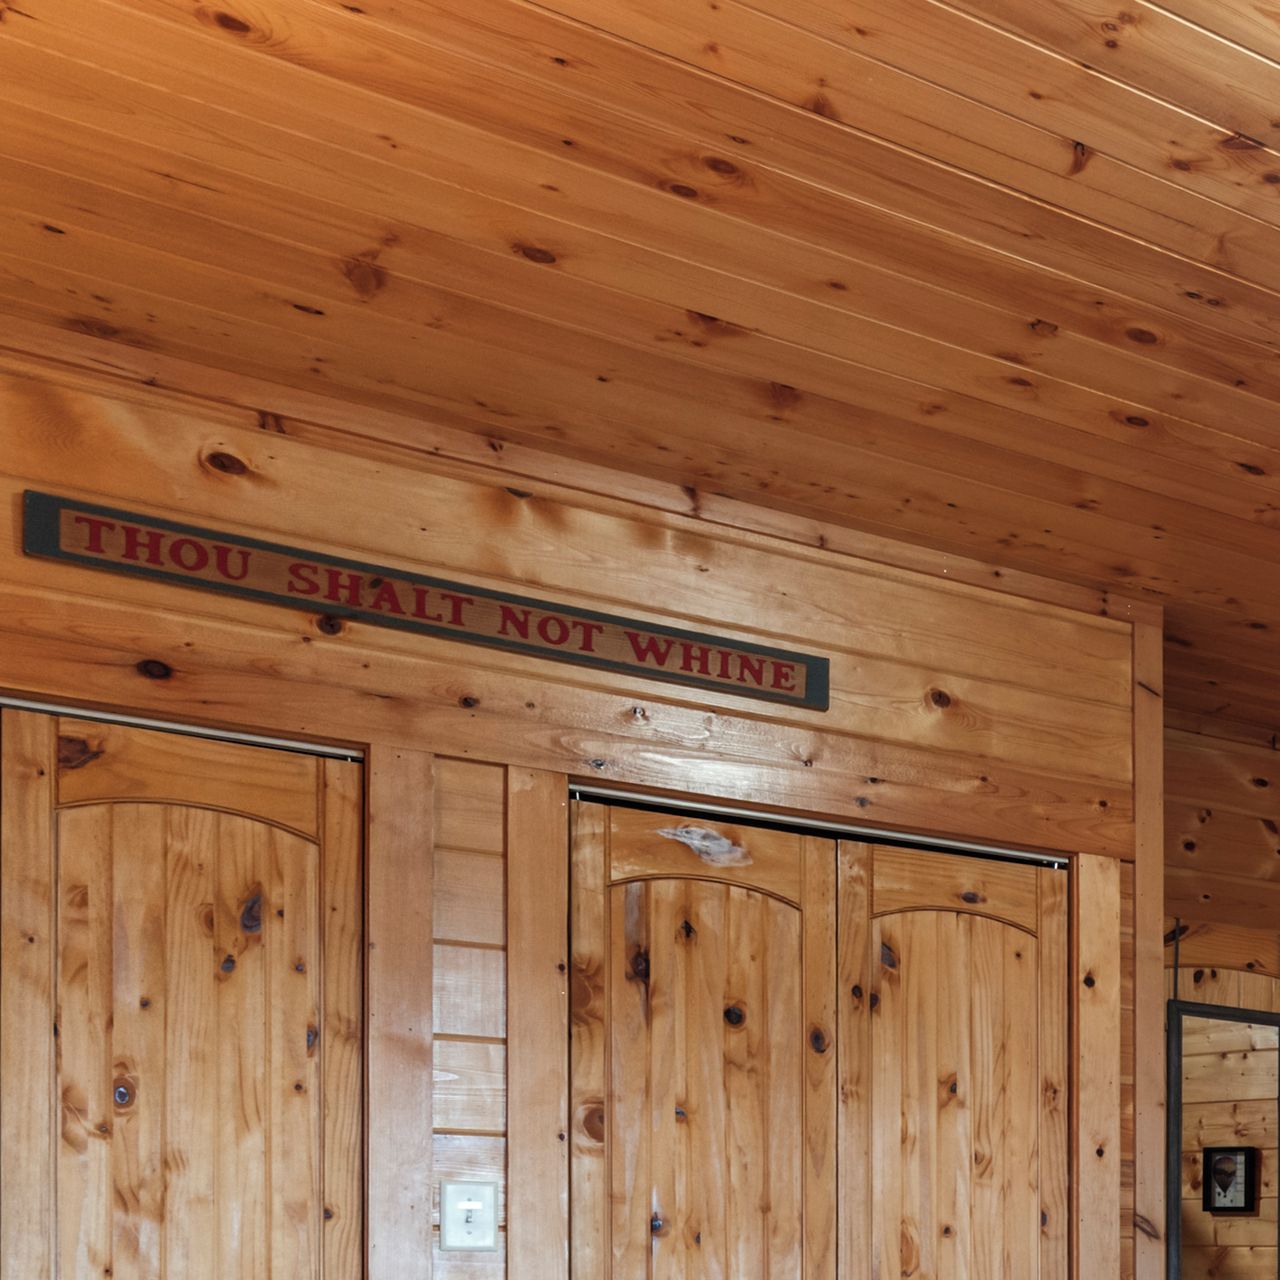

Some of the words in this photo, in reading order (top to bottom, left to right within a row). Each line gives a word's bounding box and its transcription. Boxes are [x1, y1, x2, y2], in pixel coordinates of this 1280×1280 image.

[74, 515, 254, 582] THOU
[287, 560, 473, 630] SHALT
[498, 608, 606, 654] NOT
[623, 630, 799, 695] WHINE
